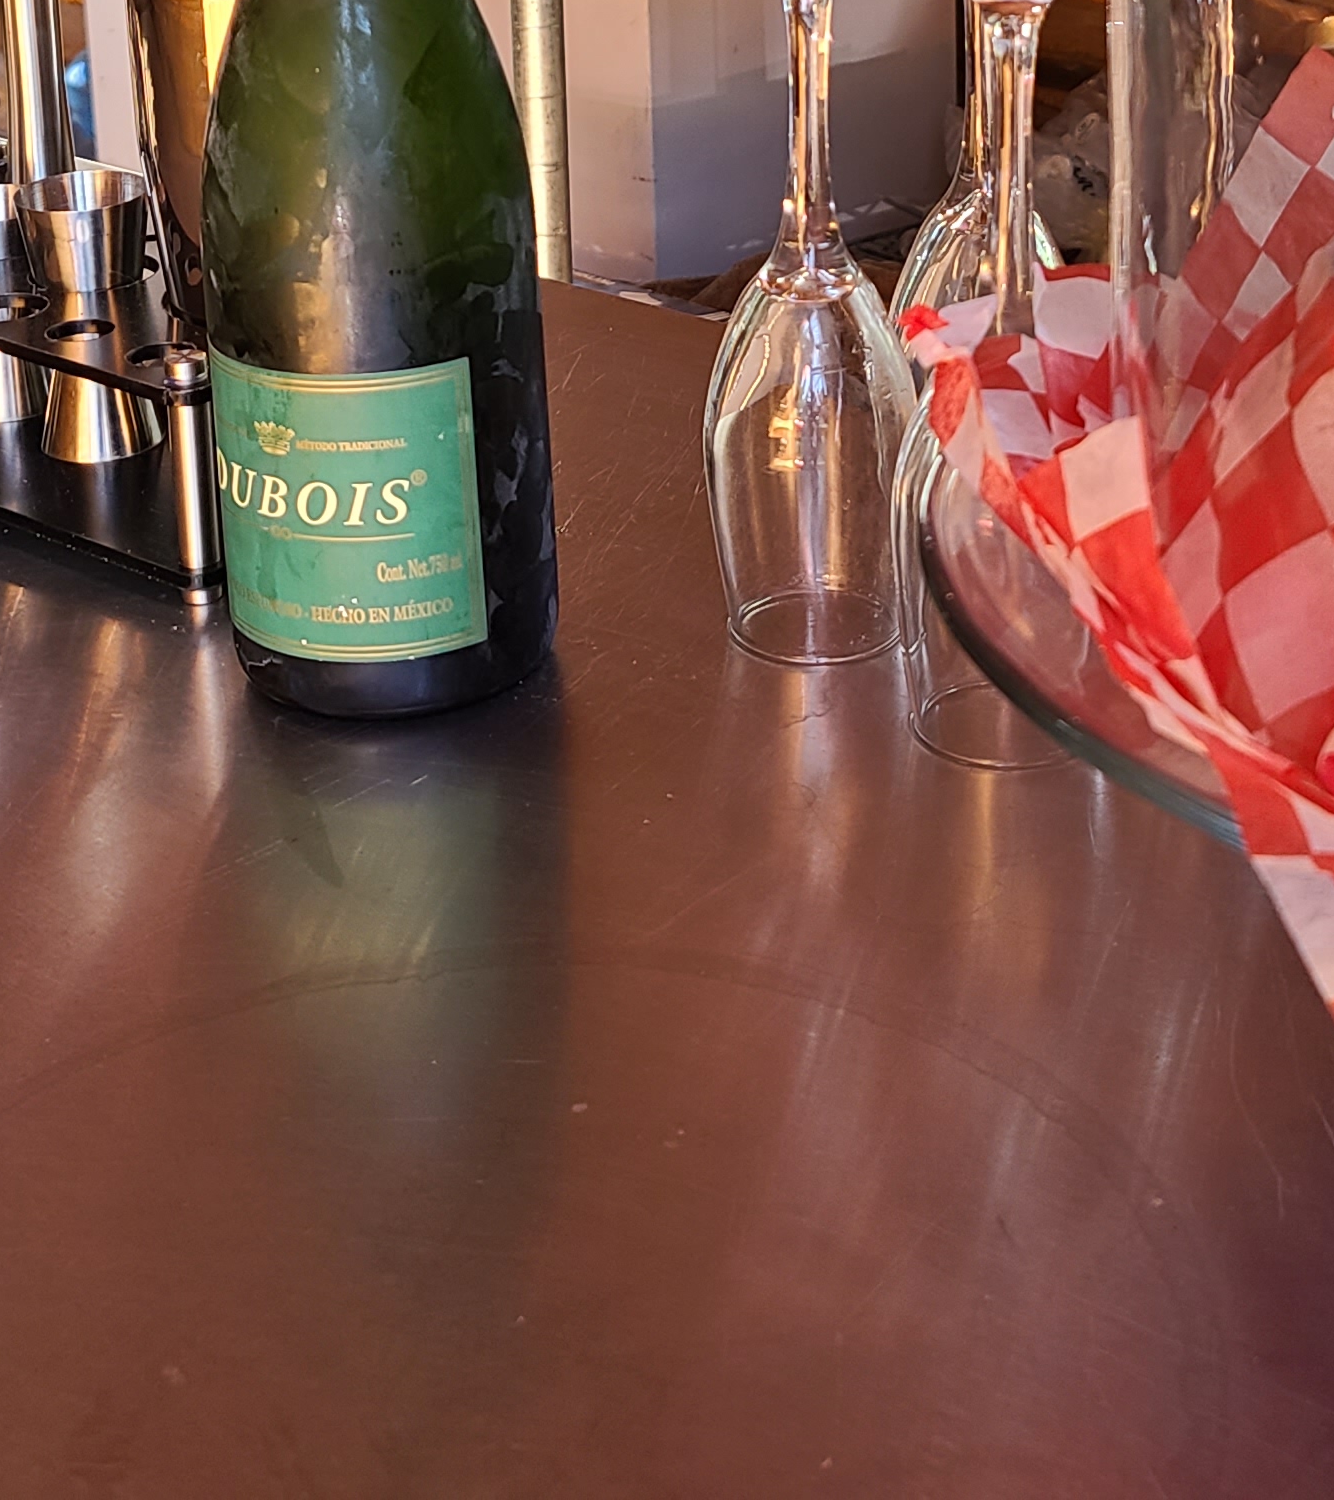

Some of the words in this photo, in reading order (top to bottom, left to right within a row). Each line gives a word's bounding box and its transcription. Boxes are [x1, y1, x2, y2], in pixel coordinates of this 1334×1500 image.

[338, 437, 407, 452] TRADICIONAL
[217, 446, 410, 526] DUBOIS
[311, 605, 366, 624] HECHO
[368, 607, 391, 623] EN
[393, 597, 454, 621] MÉXICO
